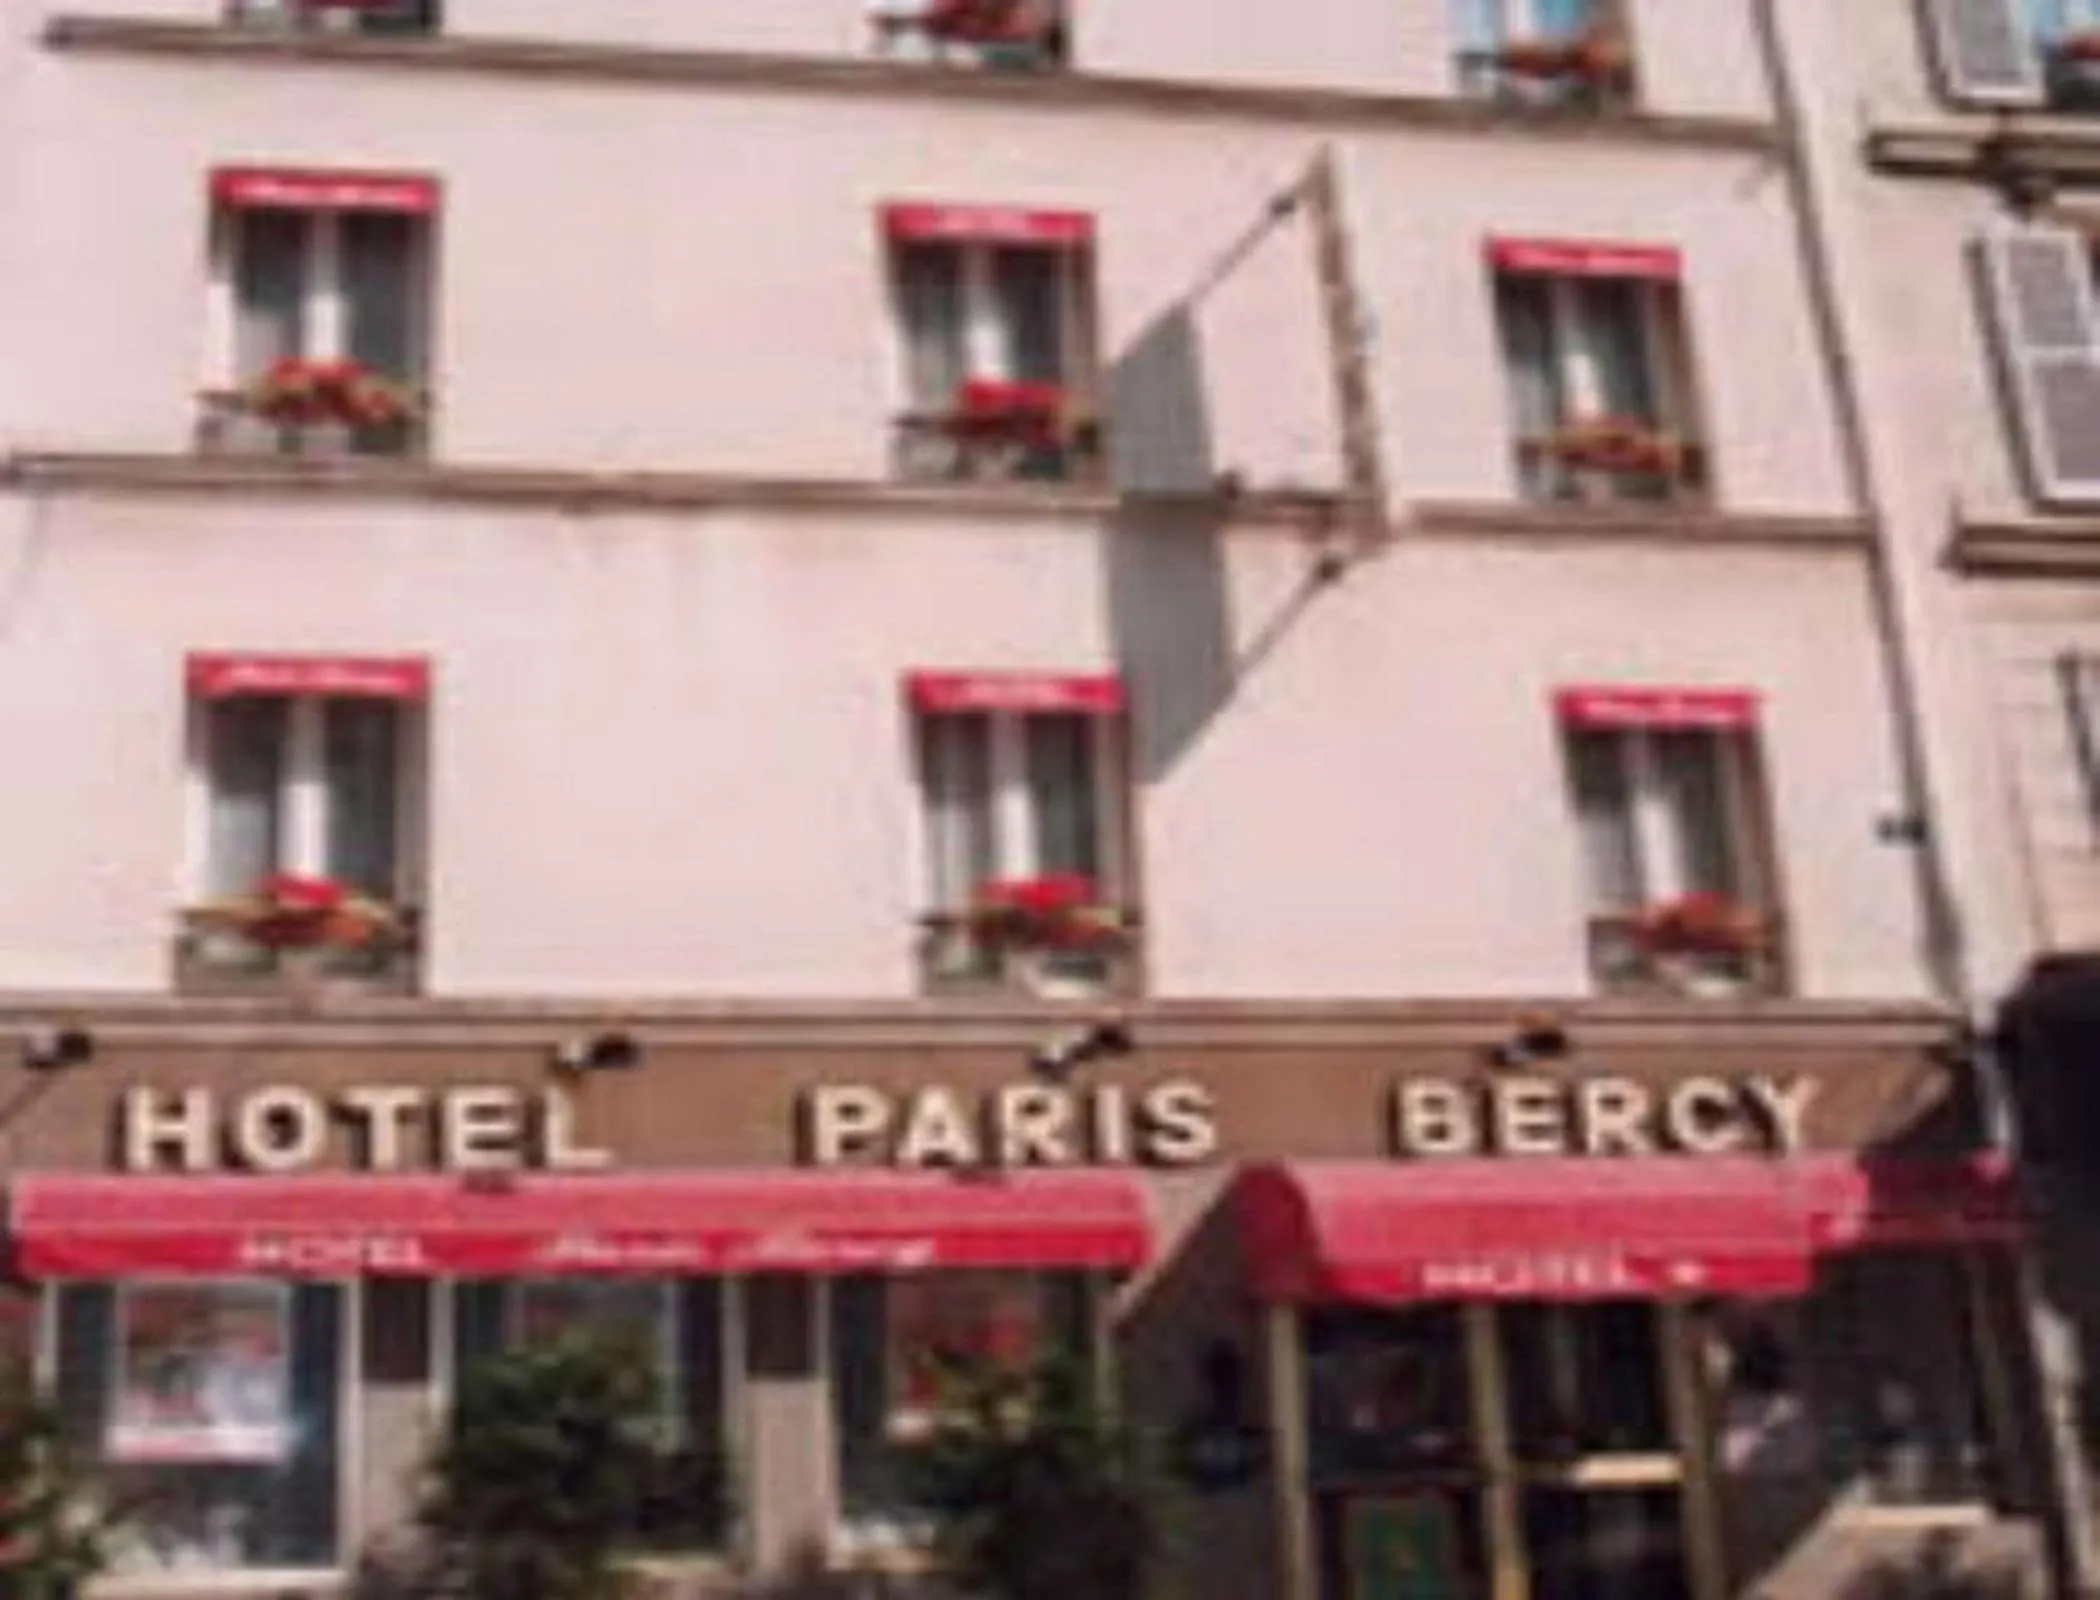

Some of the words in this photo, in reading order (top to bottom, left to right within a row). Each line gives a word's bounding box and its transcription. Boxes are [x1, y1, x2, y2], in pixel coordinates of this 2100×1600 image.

[126, 1085, 612, 1170] HOTEL
[813, 1083, 1217, 1167] PARIS
[1400, 1076, 1820, 1158] BERCY
